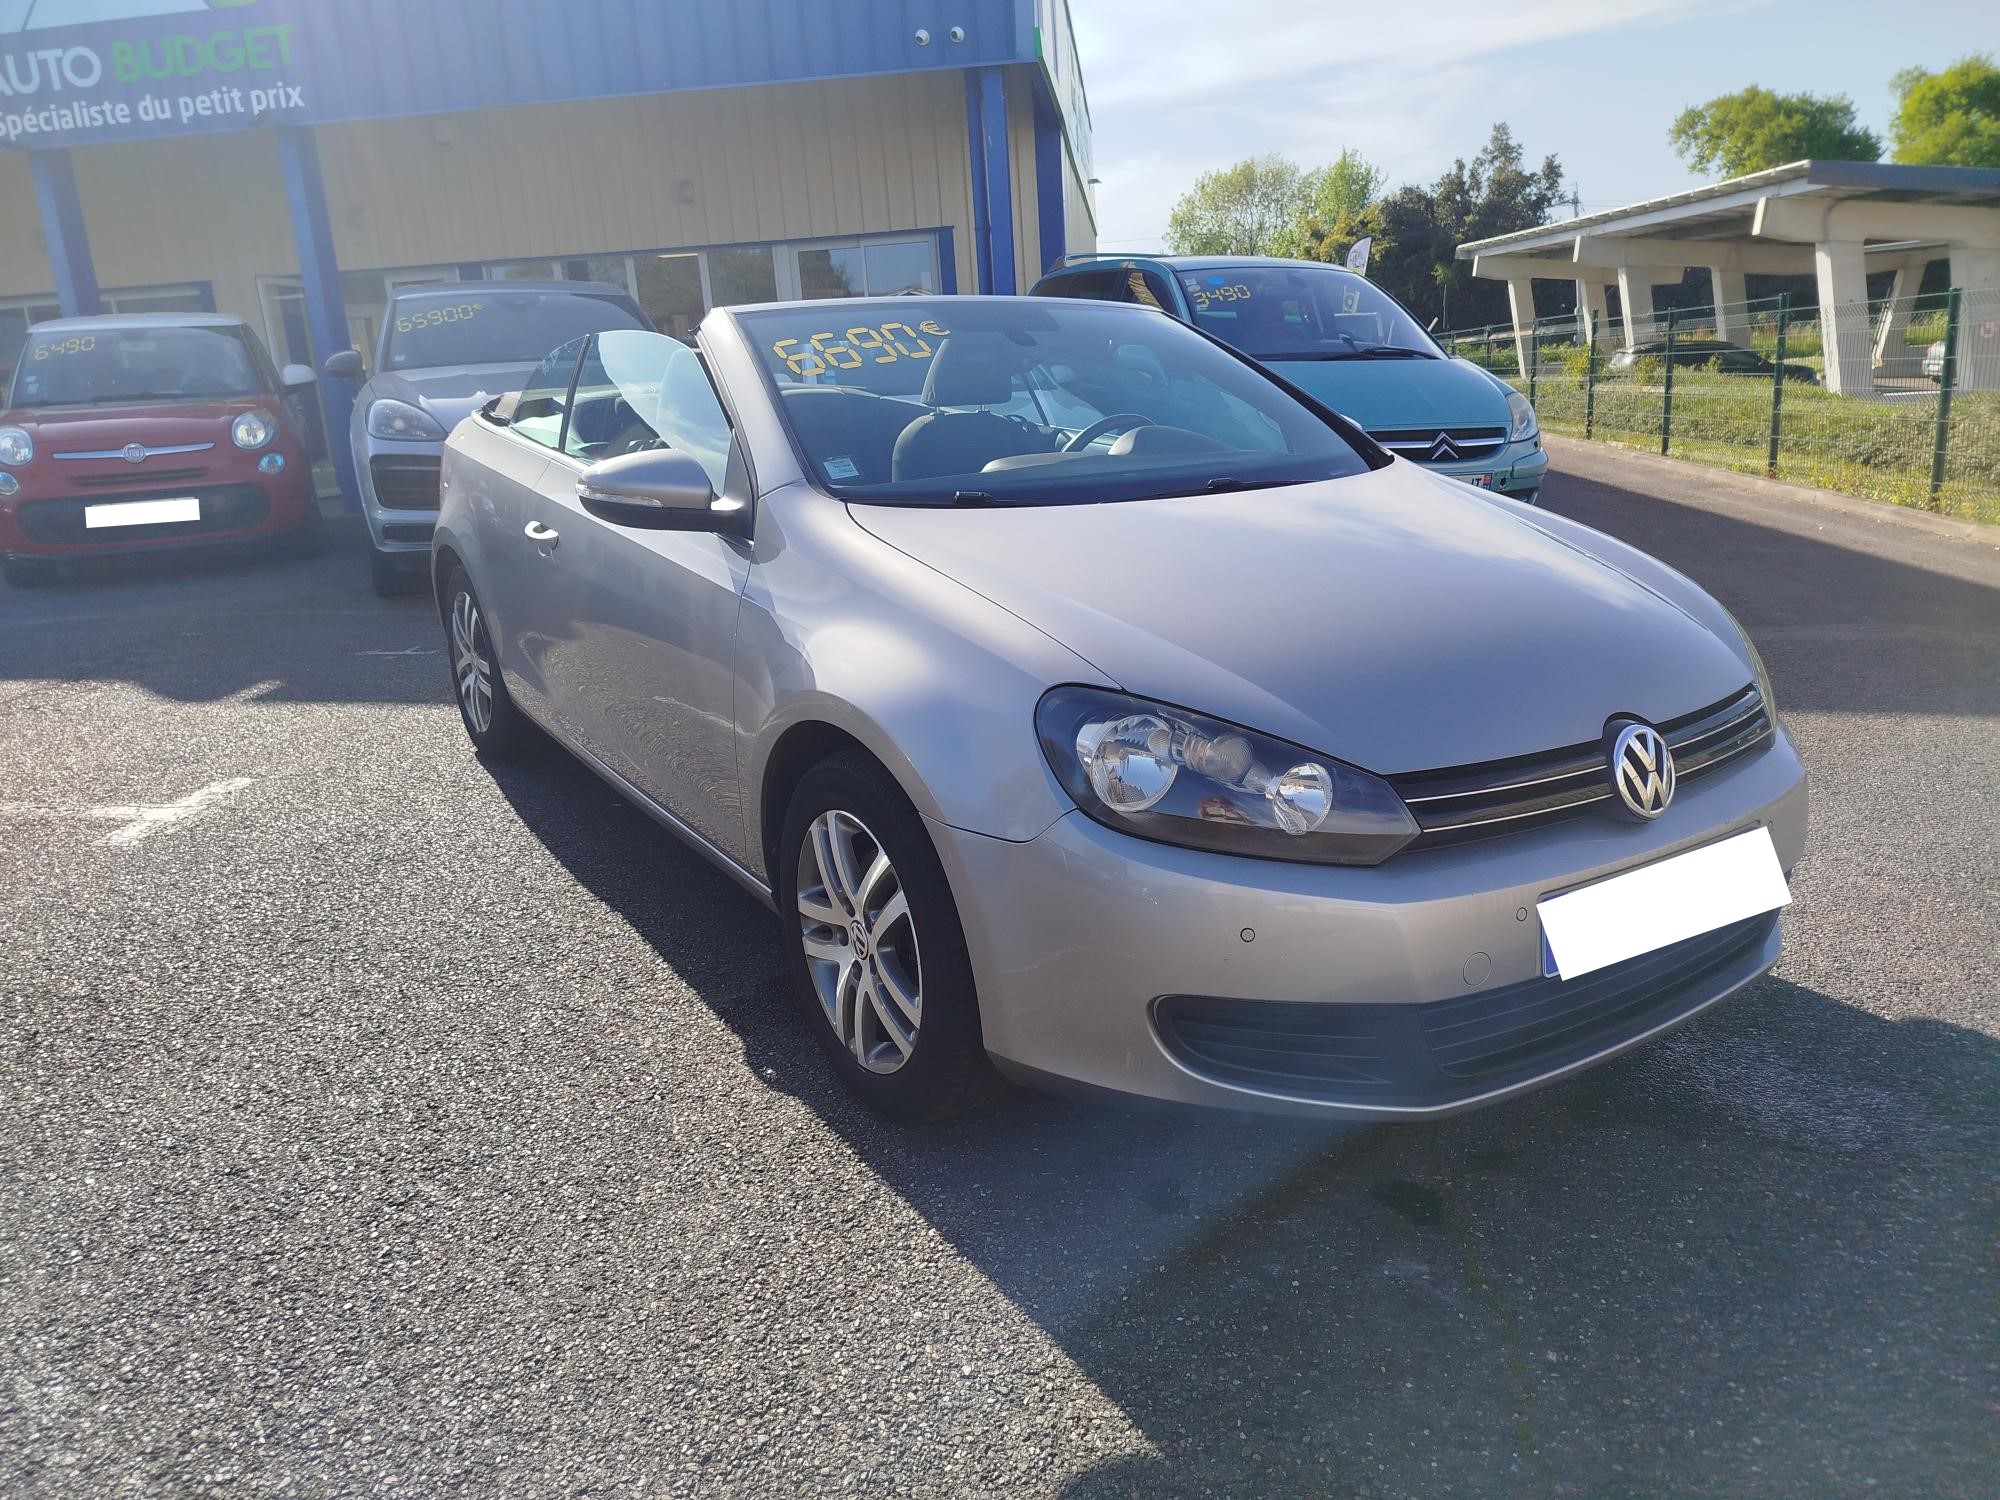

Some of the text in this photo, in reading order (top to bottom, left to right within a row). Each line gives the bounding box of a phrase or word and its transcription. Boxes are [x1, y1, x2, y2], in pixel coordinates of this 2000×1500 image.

[111, 24, 295, 83] BUDGET
[138, 94, 172, 122] du
[179, 86, 245, 124] petit
[250, 81, 305, 116] prix
[1194, 284, 1252, 308] 3490
[34, 335, 96, 361] 6490
